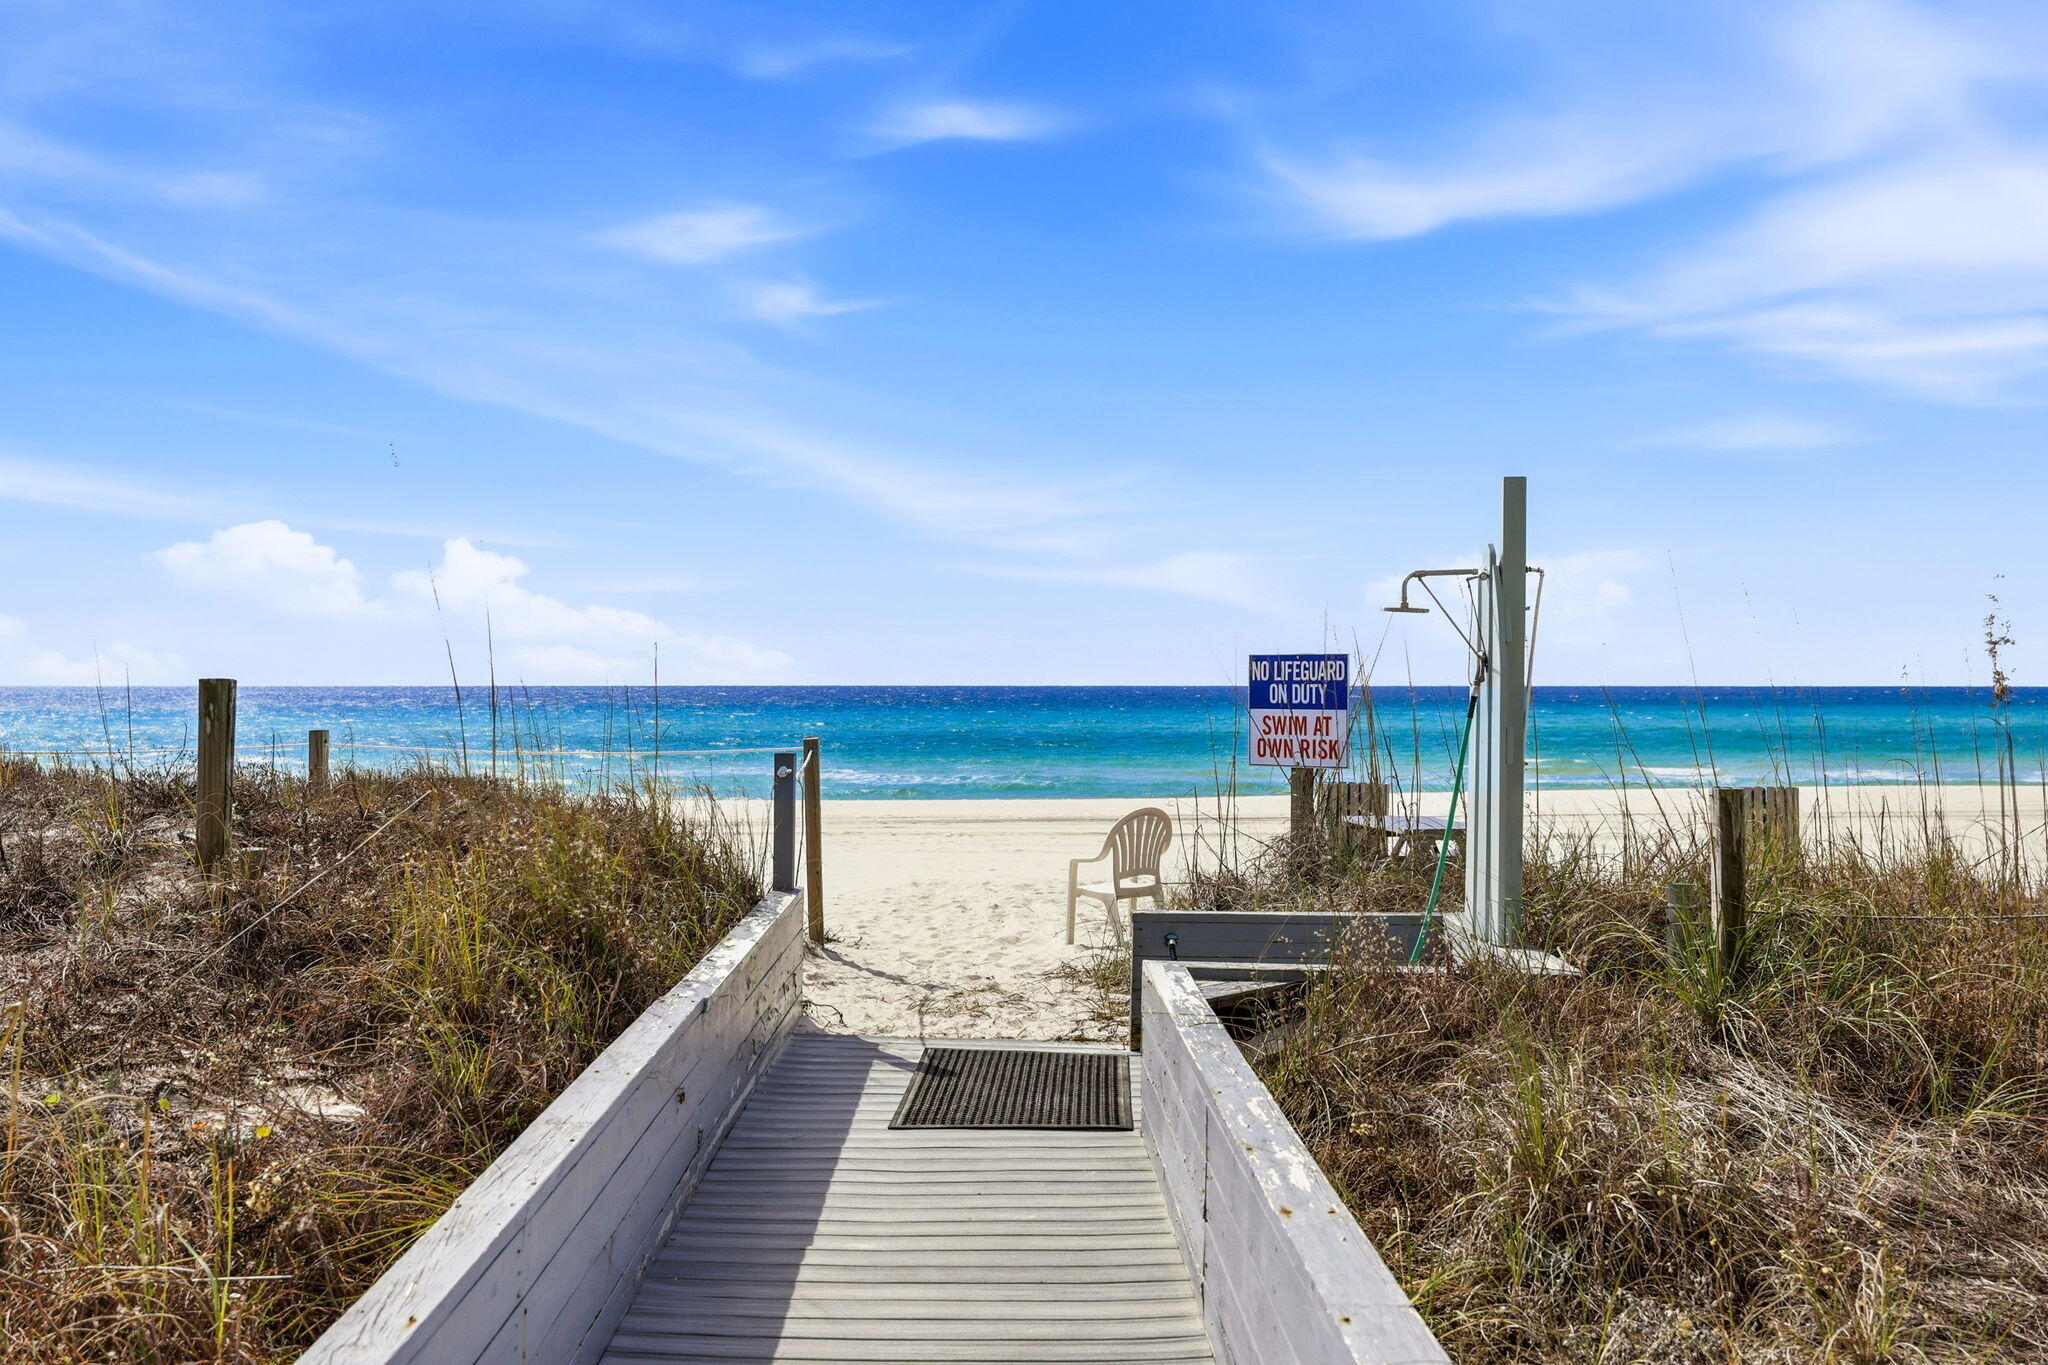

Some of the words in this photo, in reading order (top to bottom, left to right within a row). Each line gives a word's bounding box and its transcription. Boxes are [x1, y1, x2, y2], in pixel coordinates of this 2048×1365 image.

[1252, 661, 1269, 681] NO
[1274, 660, 1345, 681] LIFEGUARD
[1270, 683, 1287, 704] ON
[1292, 684, 1327, 704] DUTY
[1262, 715, 1307, 736] SWIM
[1313, 716, 1332, 736] AT
[1257, 738, 1294, 758] OWN
[1300, 739, 1339, 760] RISK
